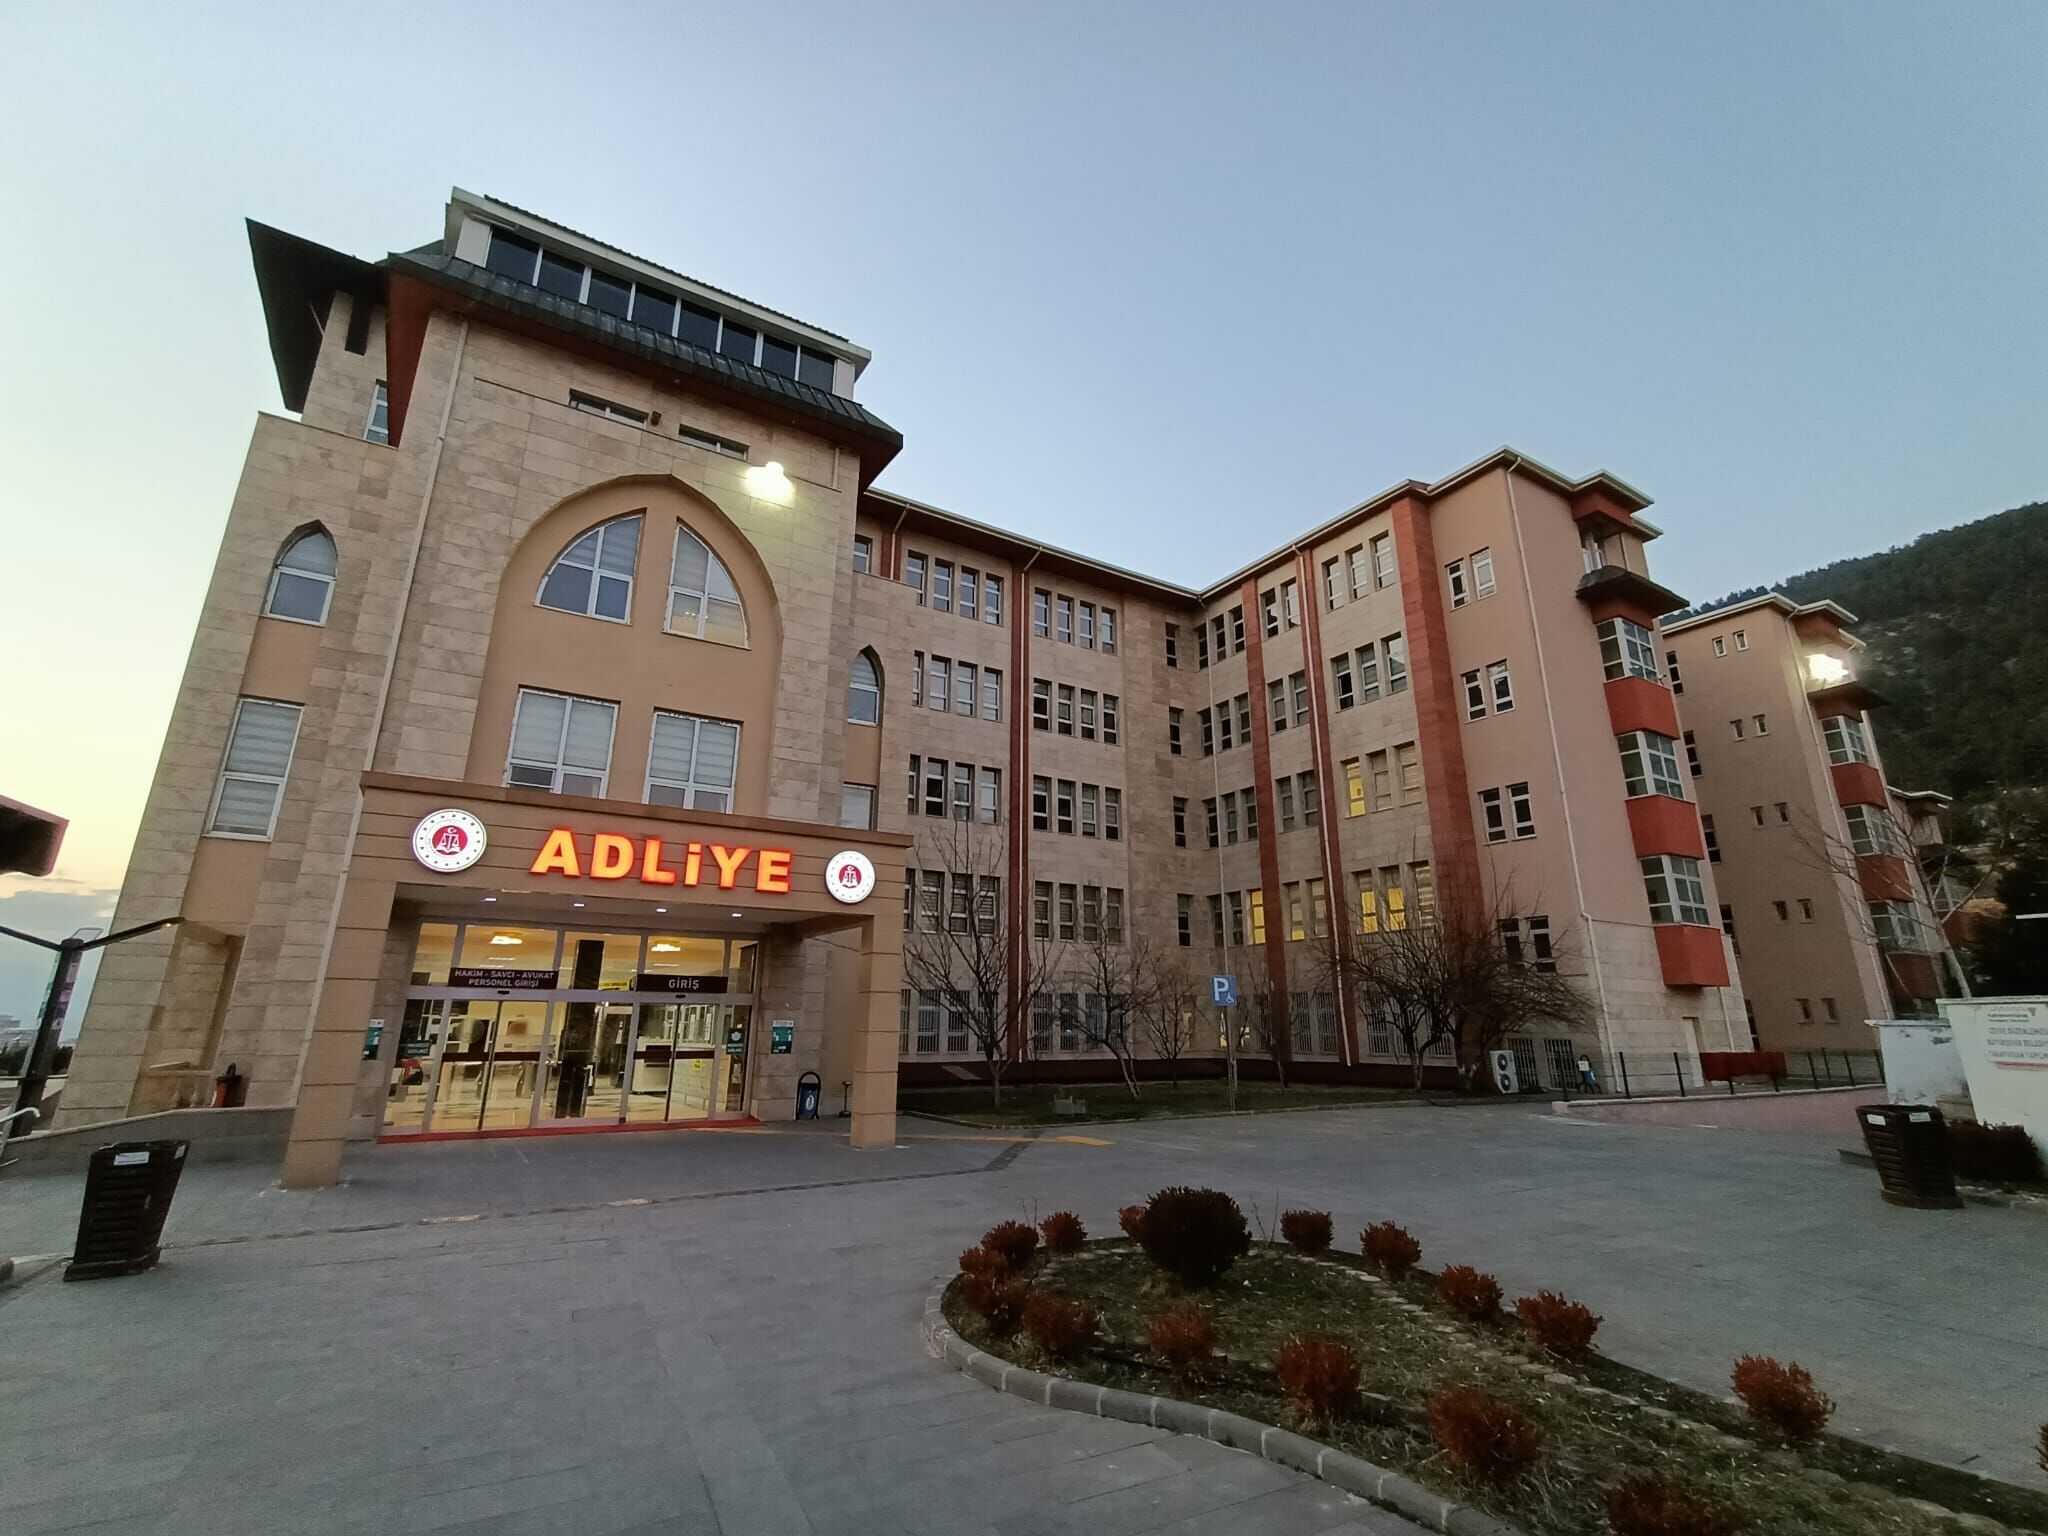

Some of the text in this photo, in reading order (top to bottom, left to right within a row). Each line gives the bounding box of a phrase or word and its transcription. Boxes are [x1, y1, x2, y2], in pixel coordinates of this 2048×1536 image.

[490, 970, 515, 978] SAVCI
[521, 971, 555, 979] AVUKAT
[468, 978, 513, 987] PERSONEL
[668, 976, 700, 990] GİRİŞ
[1213, 977, 1229, 1001] P
